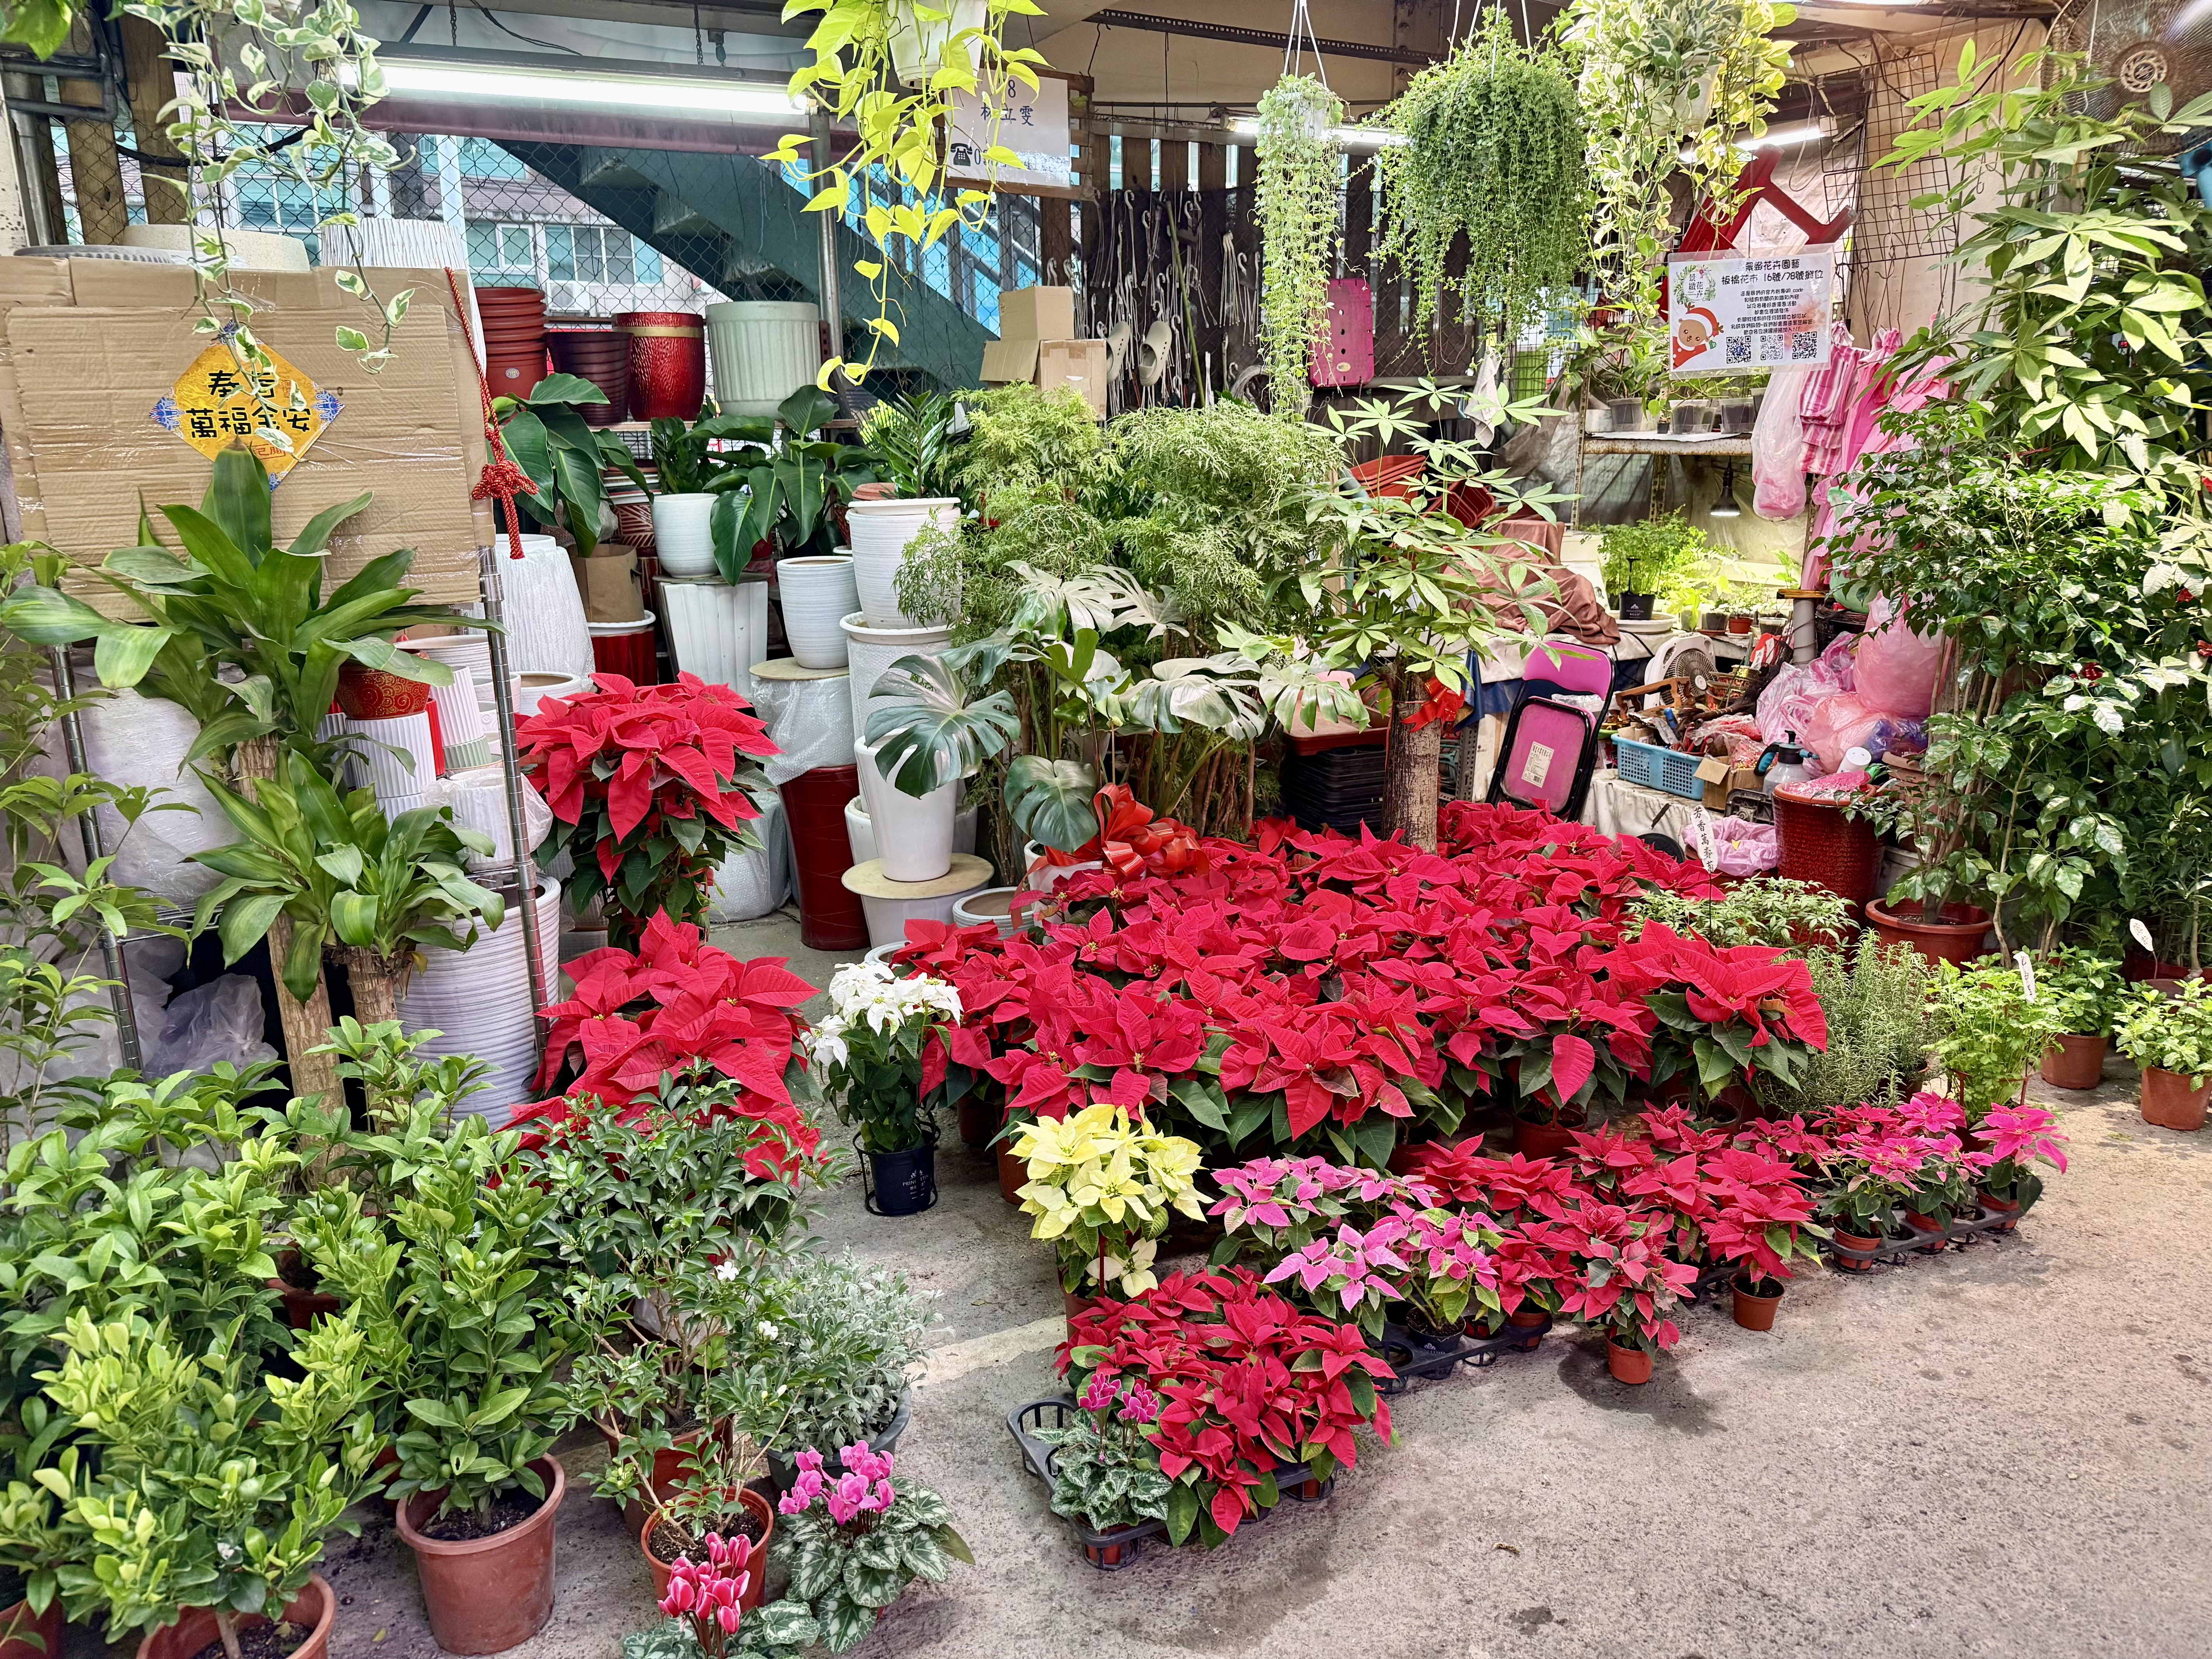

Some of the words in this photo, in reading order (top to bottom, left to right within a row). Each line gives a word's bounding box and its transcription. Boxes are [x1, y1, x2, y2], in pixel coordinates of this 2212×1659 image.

[1721, 274, 1758, 285] 板橋花市
[186, 406, 311, 438] 萬福金安
[1693, 806, 1714, 872] 芳香萬壽菊
